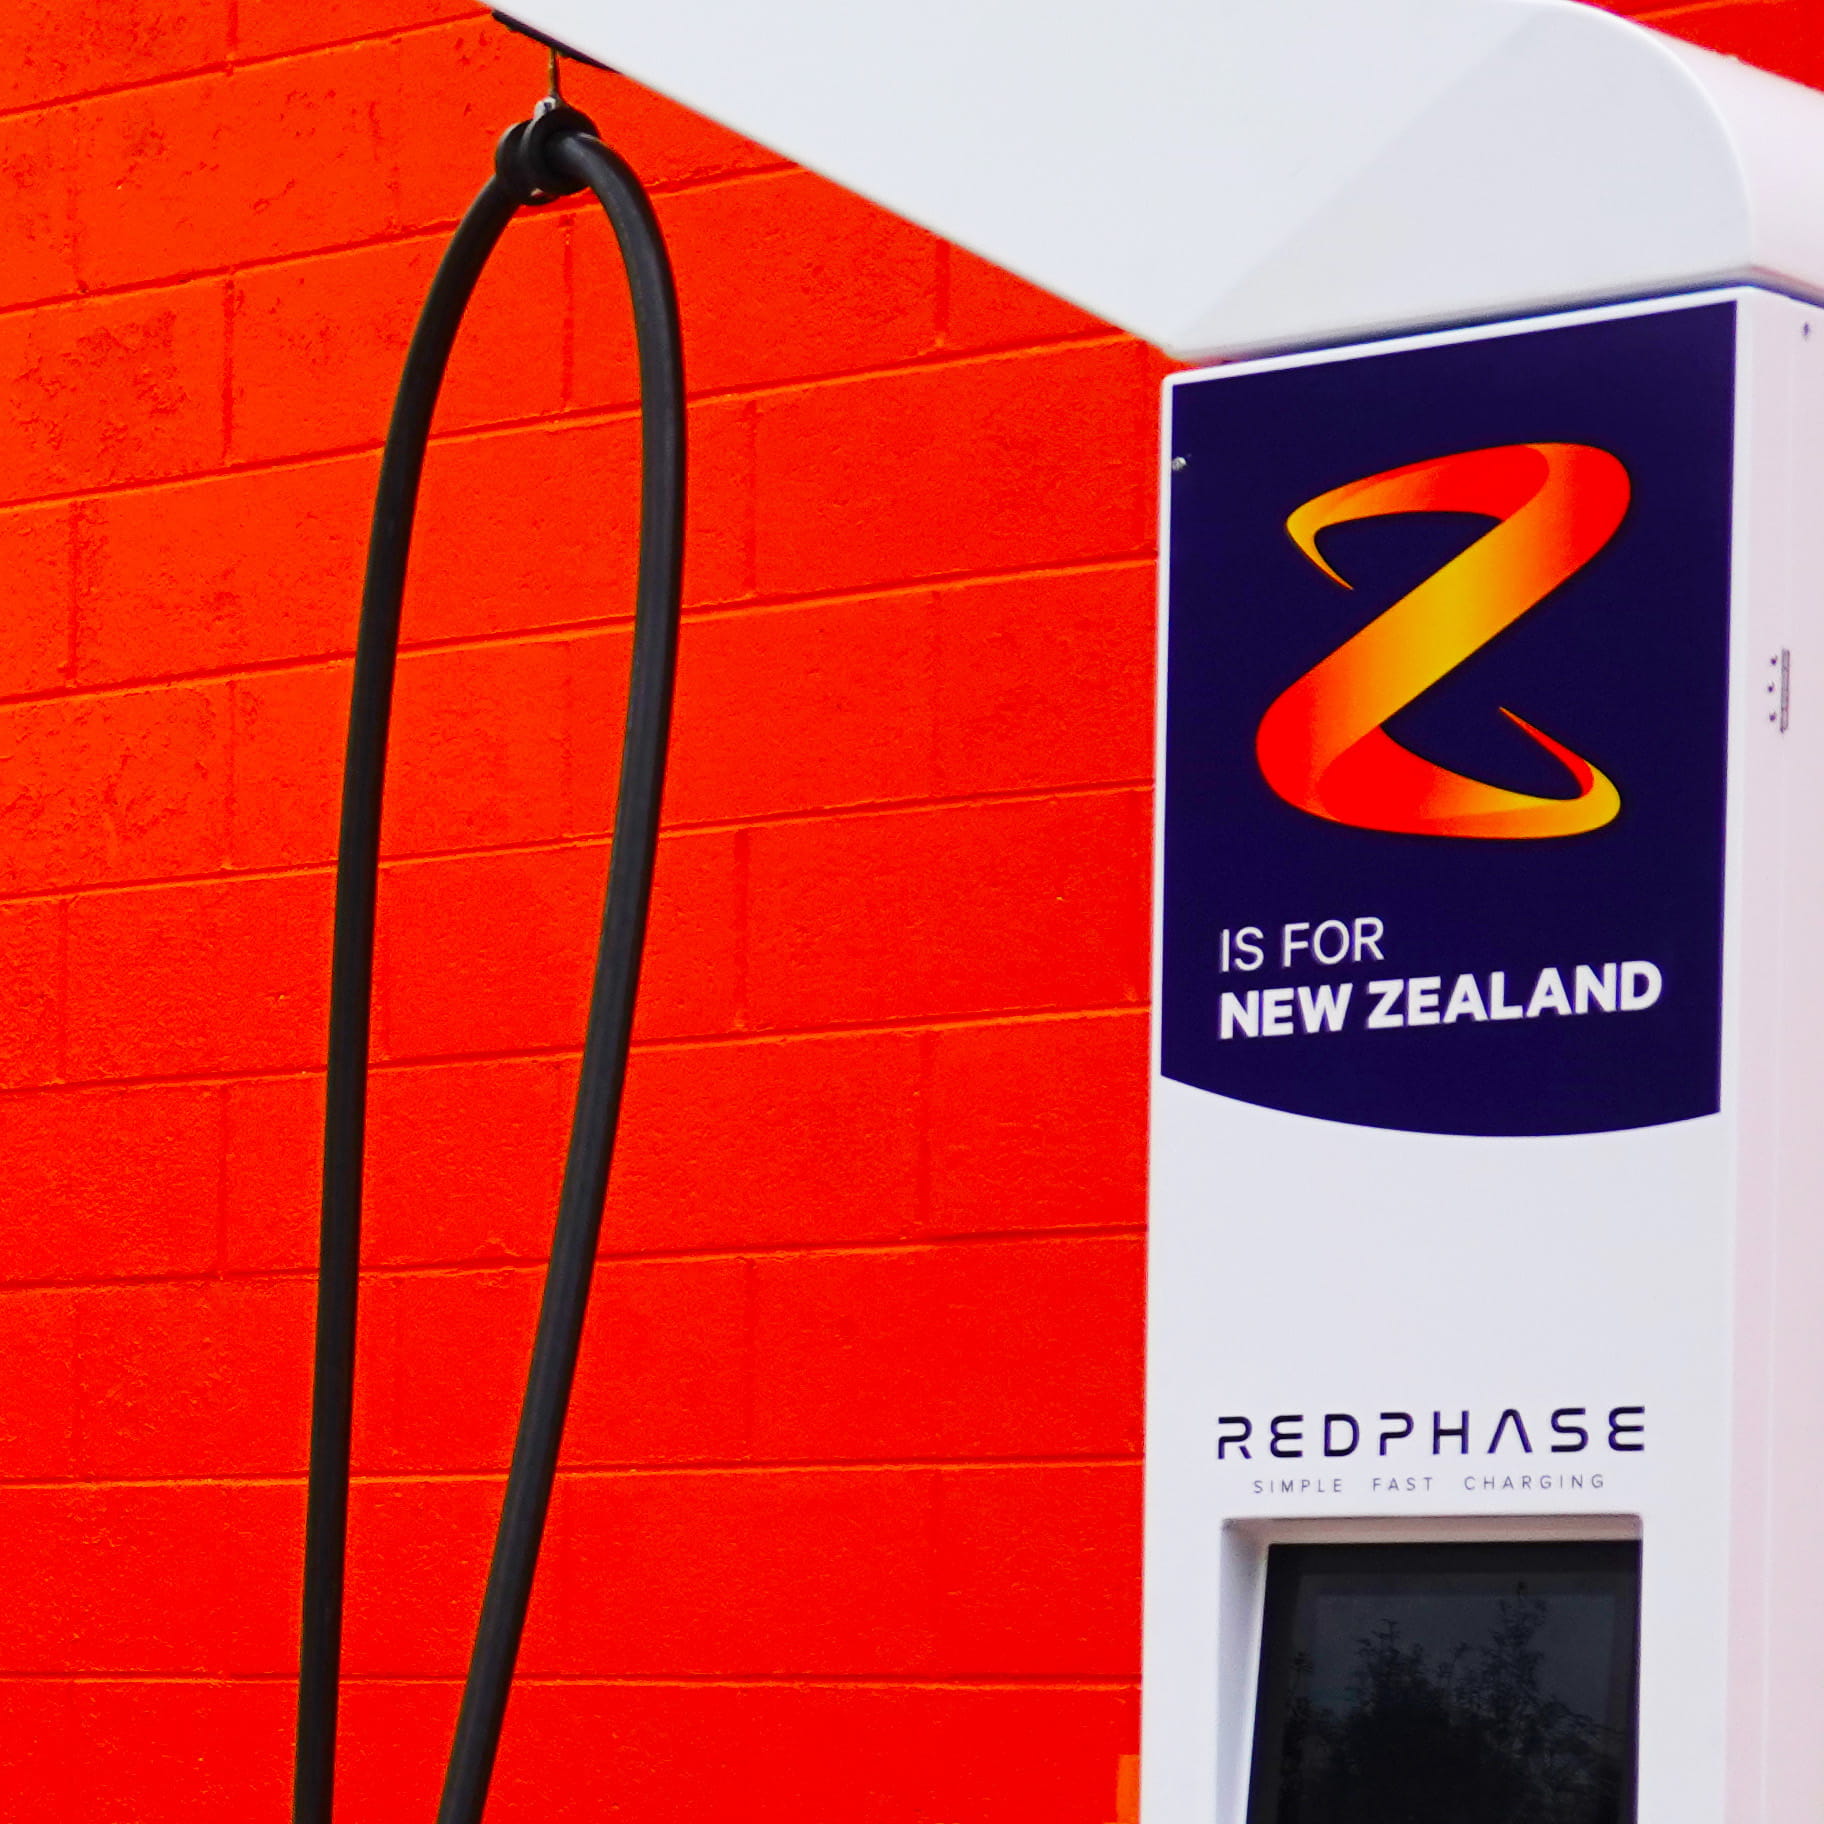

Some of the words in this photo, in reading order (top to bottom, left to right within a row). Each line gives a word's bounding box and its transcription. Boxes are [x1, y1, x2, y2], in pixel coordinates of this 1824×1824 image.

[1256, 442, 1631, 840] Z
[1220, 927, 1264, 972] IS
[1282, 917, 1385, 968] FOR
[1218, 983, 1356, 1039] NEW
[1367, 960, 1663, 1029] ZEALAND
[1217, 1406, 1645, 1460] REDPHASE
[1253, 1478, 1344, 1494] SIMPLE
[1372, 1476, 1434, 1492] FAST
[1464, 1473, 1606, 1491] CHARGING
